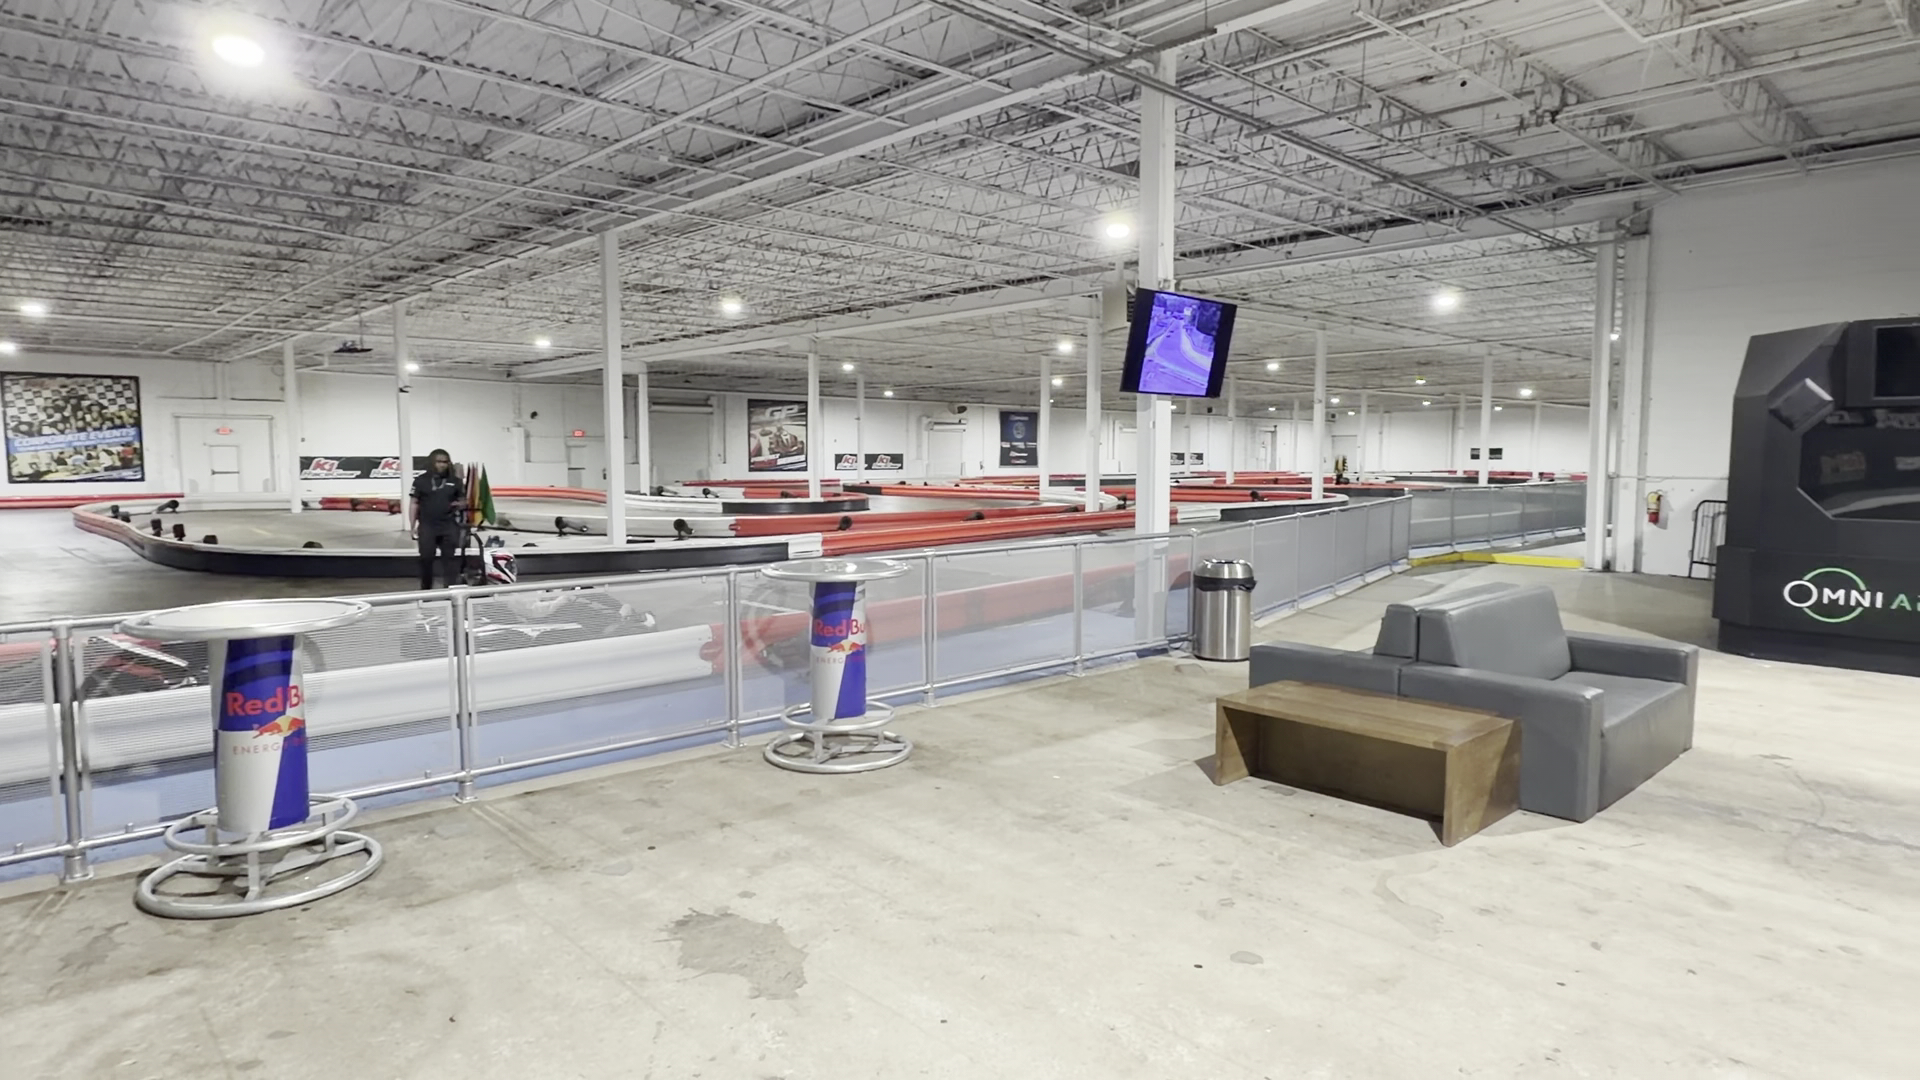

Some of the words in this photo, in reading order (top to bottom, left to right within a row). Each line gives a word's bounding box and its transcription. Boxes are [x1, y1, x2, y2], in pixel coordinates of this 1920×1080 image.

[14, 432, 89, 447] CORPORATE
[89, 427, 136, 439] EVENTS
[312, 459, 336, 471] K1
[1783, 580, 1883, 608] OMNI
[1890, 593, 1920, 612] A
[815, 619, 847, 637] Red
[226, 687, 284, 716] Red
